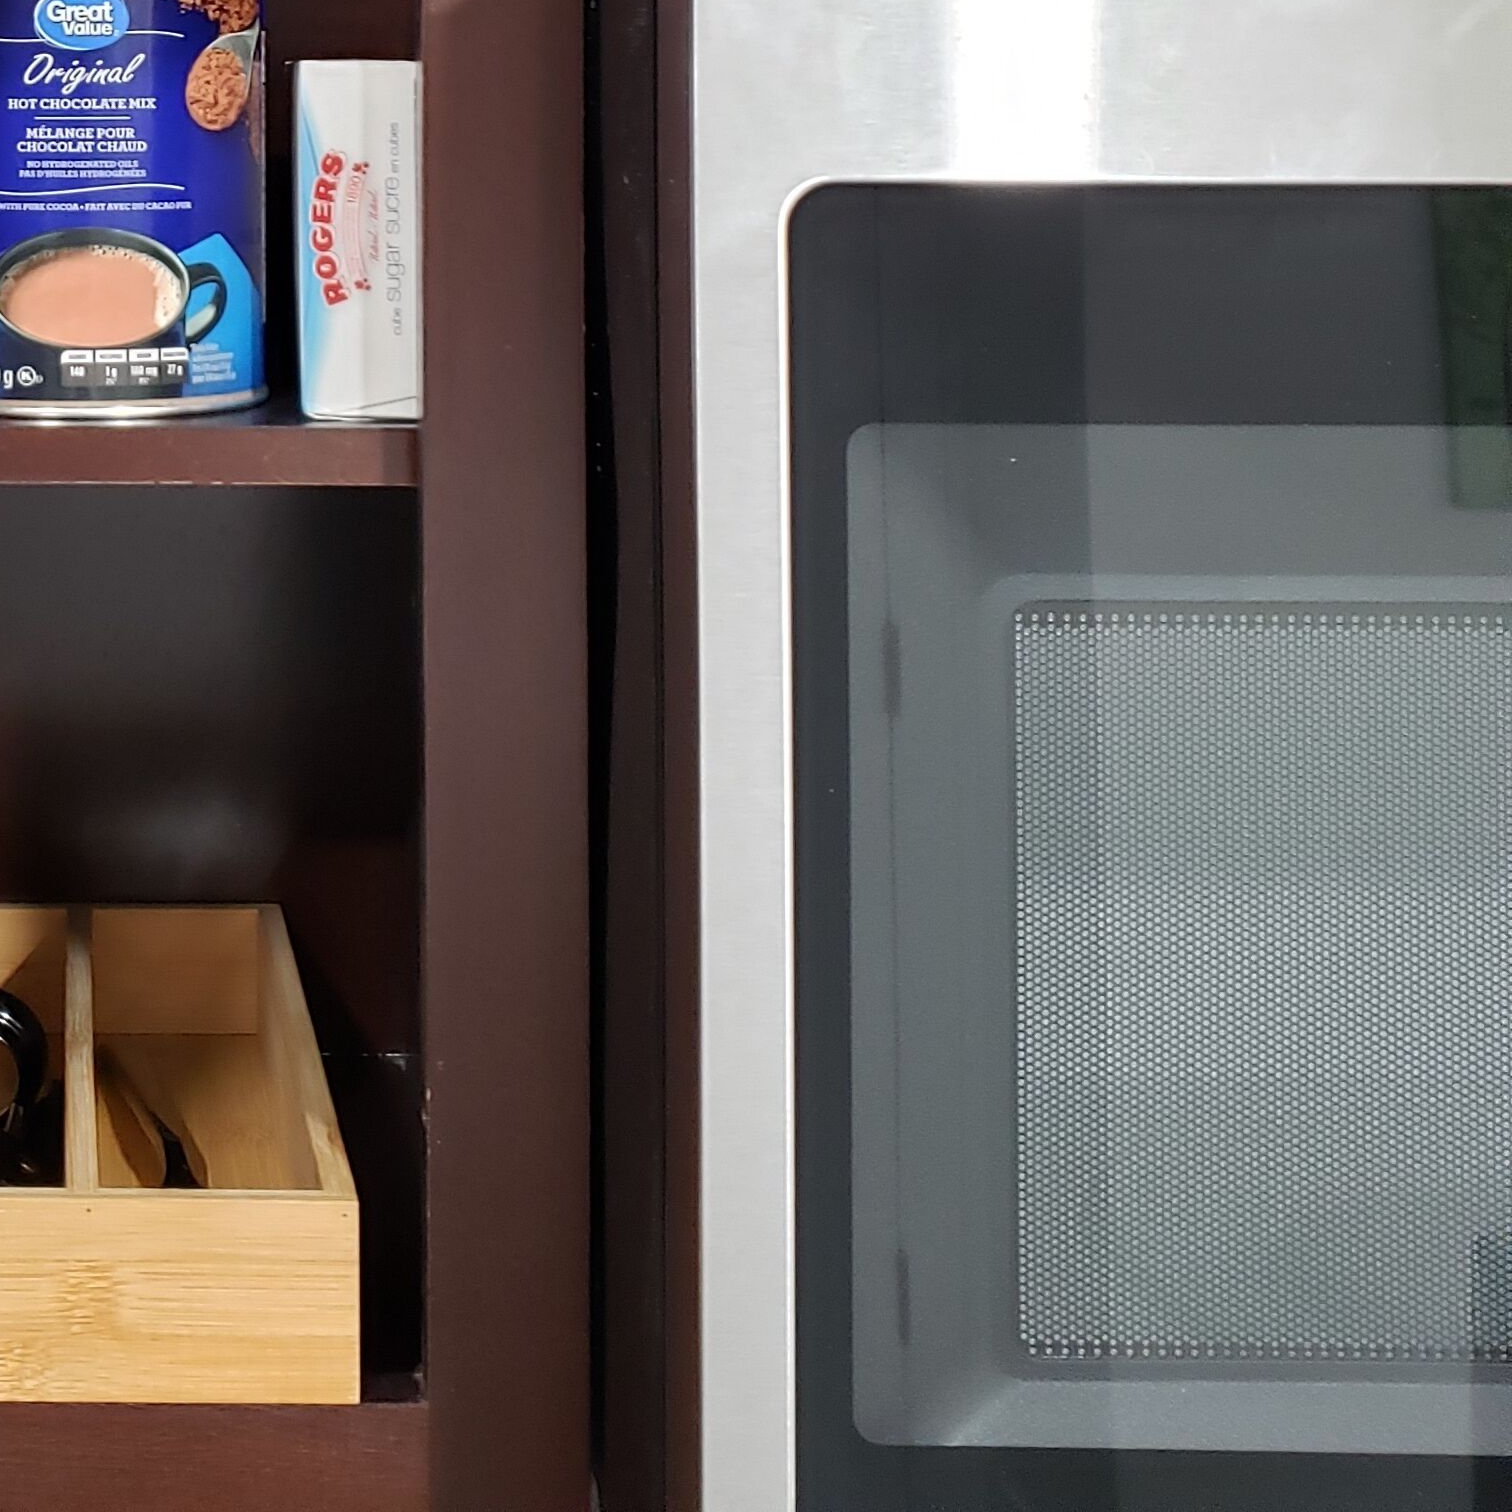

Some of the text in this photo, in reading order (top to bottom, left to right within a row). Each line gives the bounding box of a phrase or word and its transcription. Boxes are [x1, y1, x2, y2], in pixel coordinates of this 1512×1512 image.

[46, 0, 114, 23] Great
[60, 20, 114, 37] Value
[23, 53, 146, 94] Original
[8, 98, 157, 110] HOT CHOCOLATE MIX
[26, 124, 135, 139] MÉLANGE POUR
[17, 141, 148, 152] CHOCOLAT CHAUD
[46, 203, 79, 211] COCOA
[312, 152, 348, 305] ROGERS
[384, 122, 406, 336] cube sugar sucre en cubes
[3, 370, 13, 389] g
